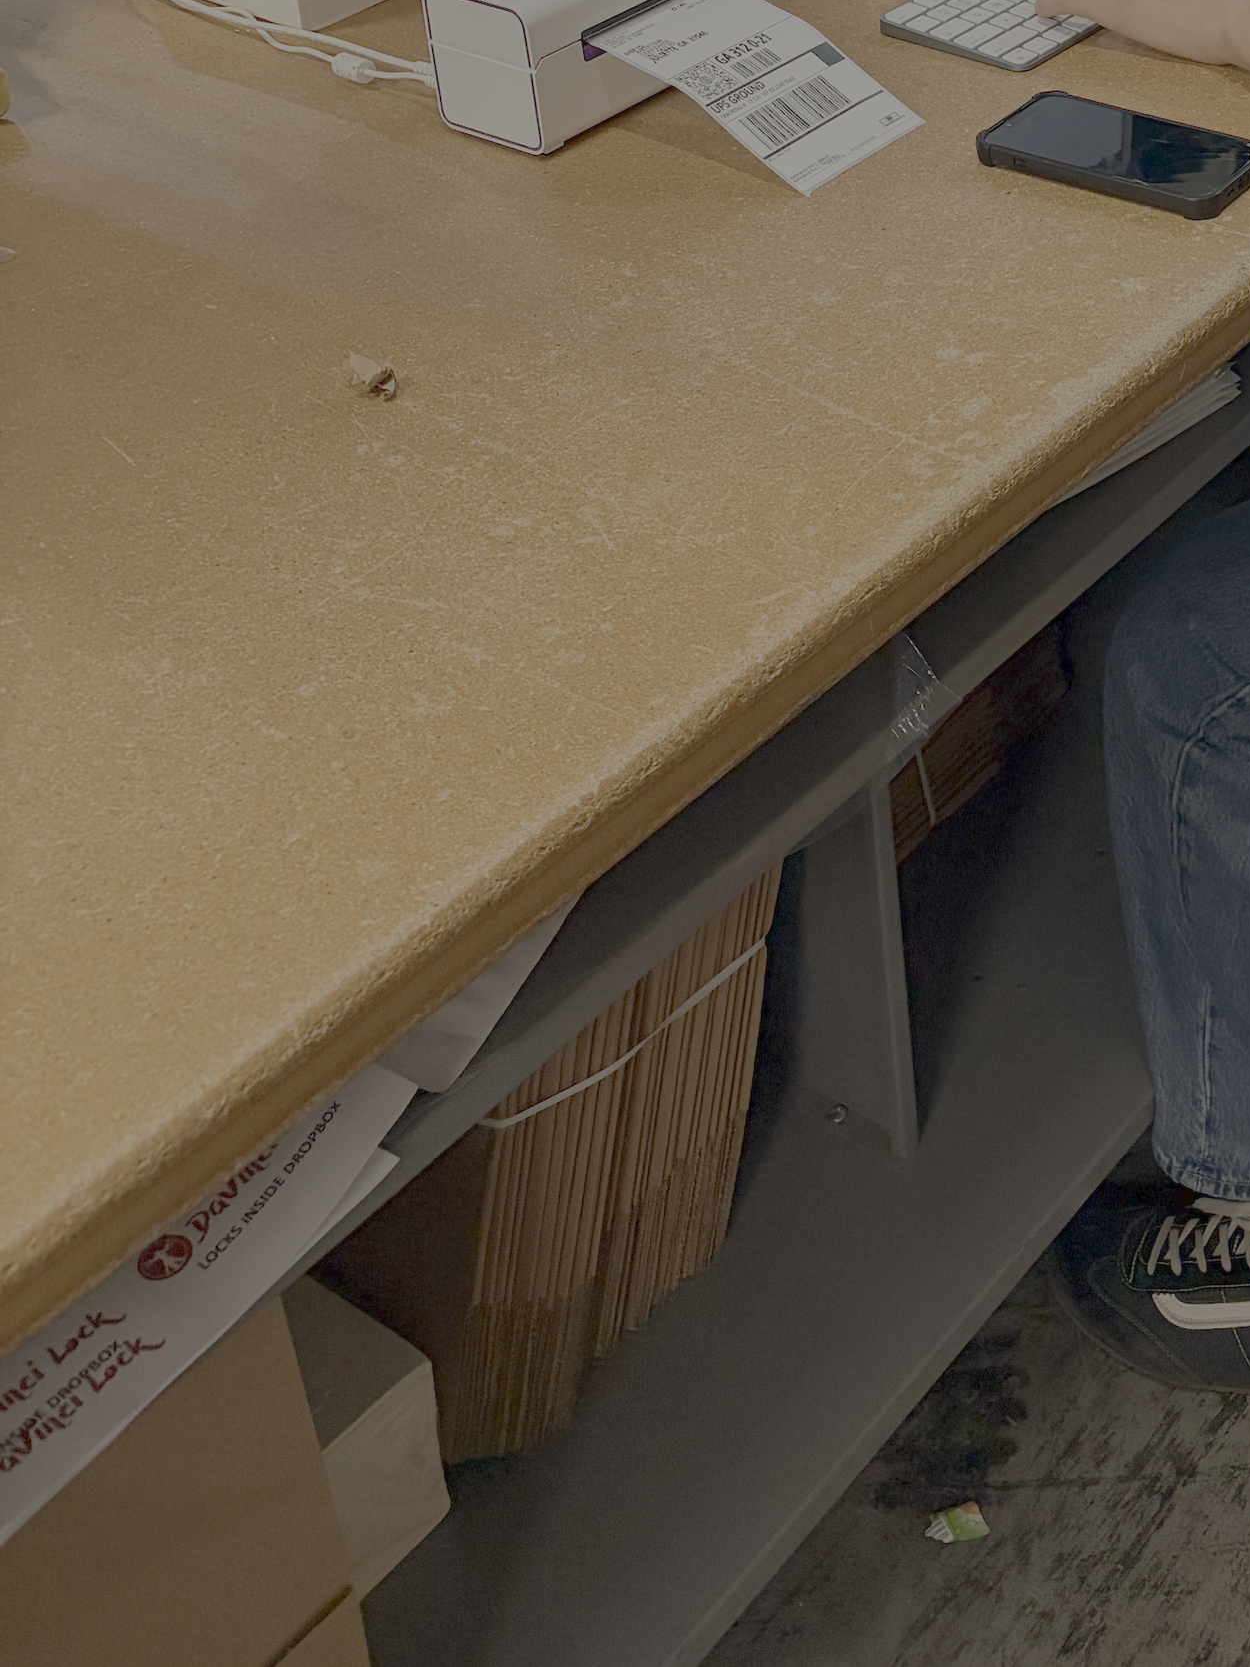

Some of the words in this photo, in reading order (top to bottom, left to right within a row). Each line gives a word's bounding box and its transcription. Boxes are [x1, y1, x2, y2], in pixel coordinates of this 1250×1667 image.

[714, 52, 736, 65] GA
[710, 99, 731, 114] UPS
[728, 80, 766, 105] GROUND
[197, 1224, 243, 1271] LOCKS
[241, 1175, 286, 1225] INSIDE
[282, 1099, 342, 1176] DROPBOX
[45, 1311, 128, 1366] Lock
[86, 1336, 167, 1394] Lock
